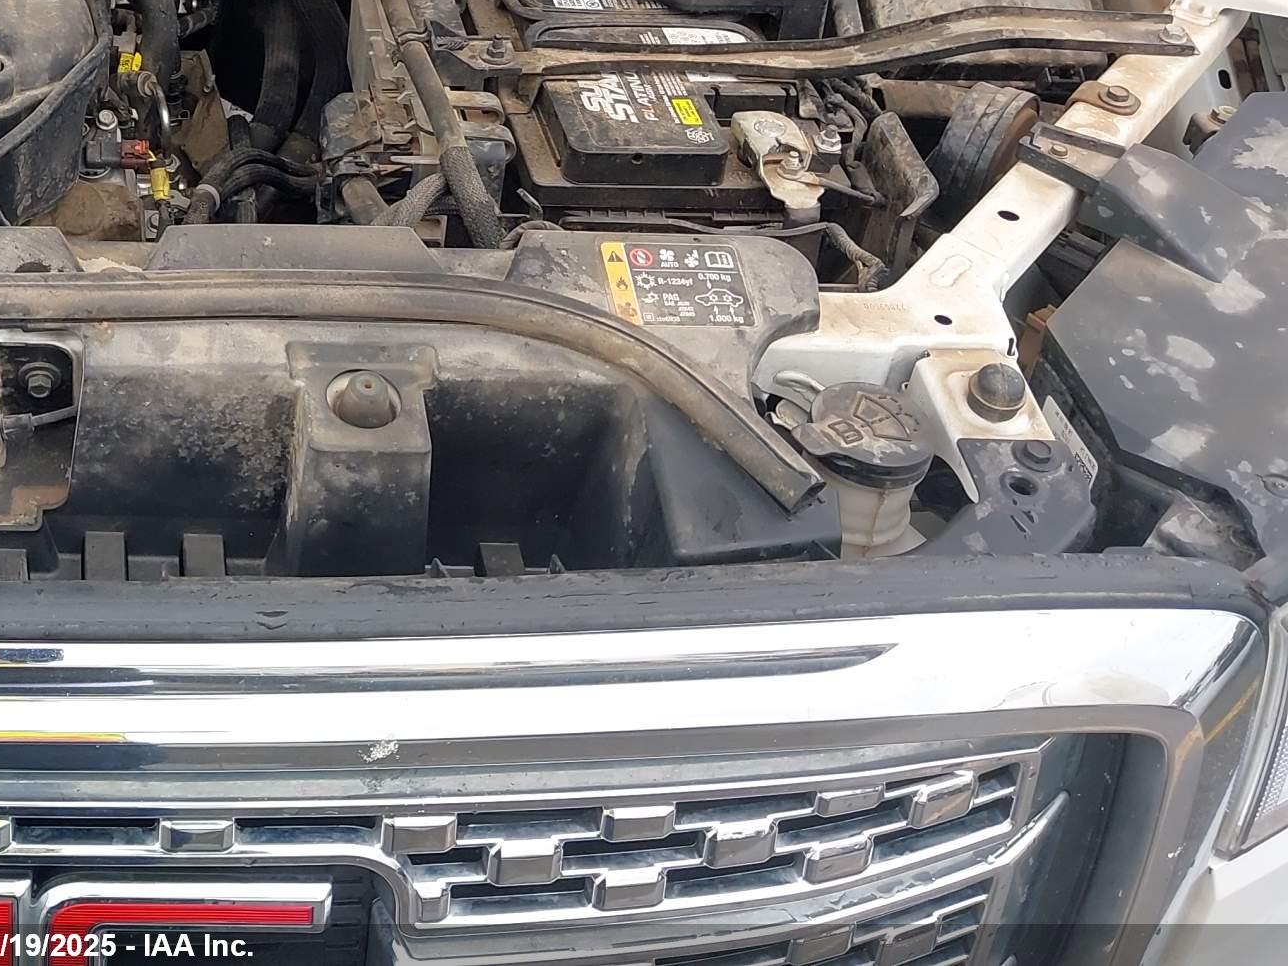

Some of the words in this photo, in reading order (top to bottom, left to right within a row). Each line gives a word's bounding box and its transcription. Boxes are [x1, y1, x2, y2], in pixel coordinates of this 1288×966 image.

[624, 71, 659, 121] PLATINU
[658, 277, 693, 287] R-1234yf
[698, 273, 720, 281] 0.700
[720, 273, 731, 282] kg
[663, 293, 679, 301] PAG
[710, 315, 732, 323] 1.000
[733, 315, 745, 324] kg
